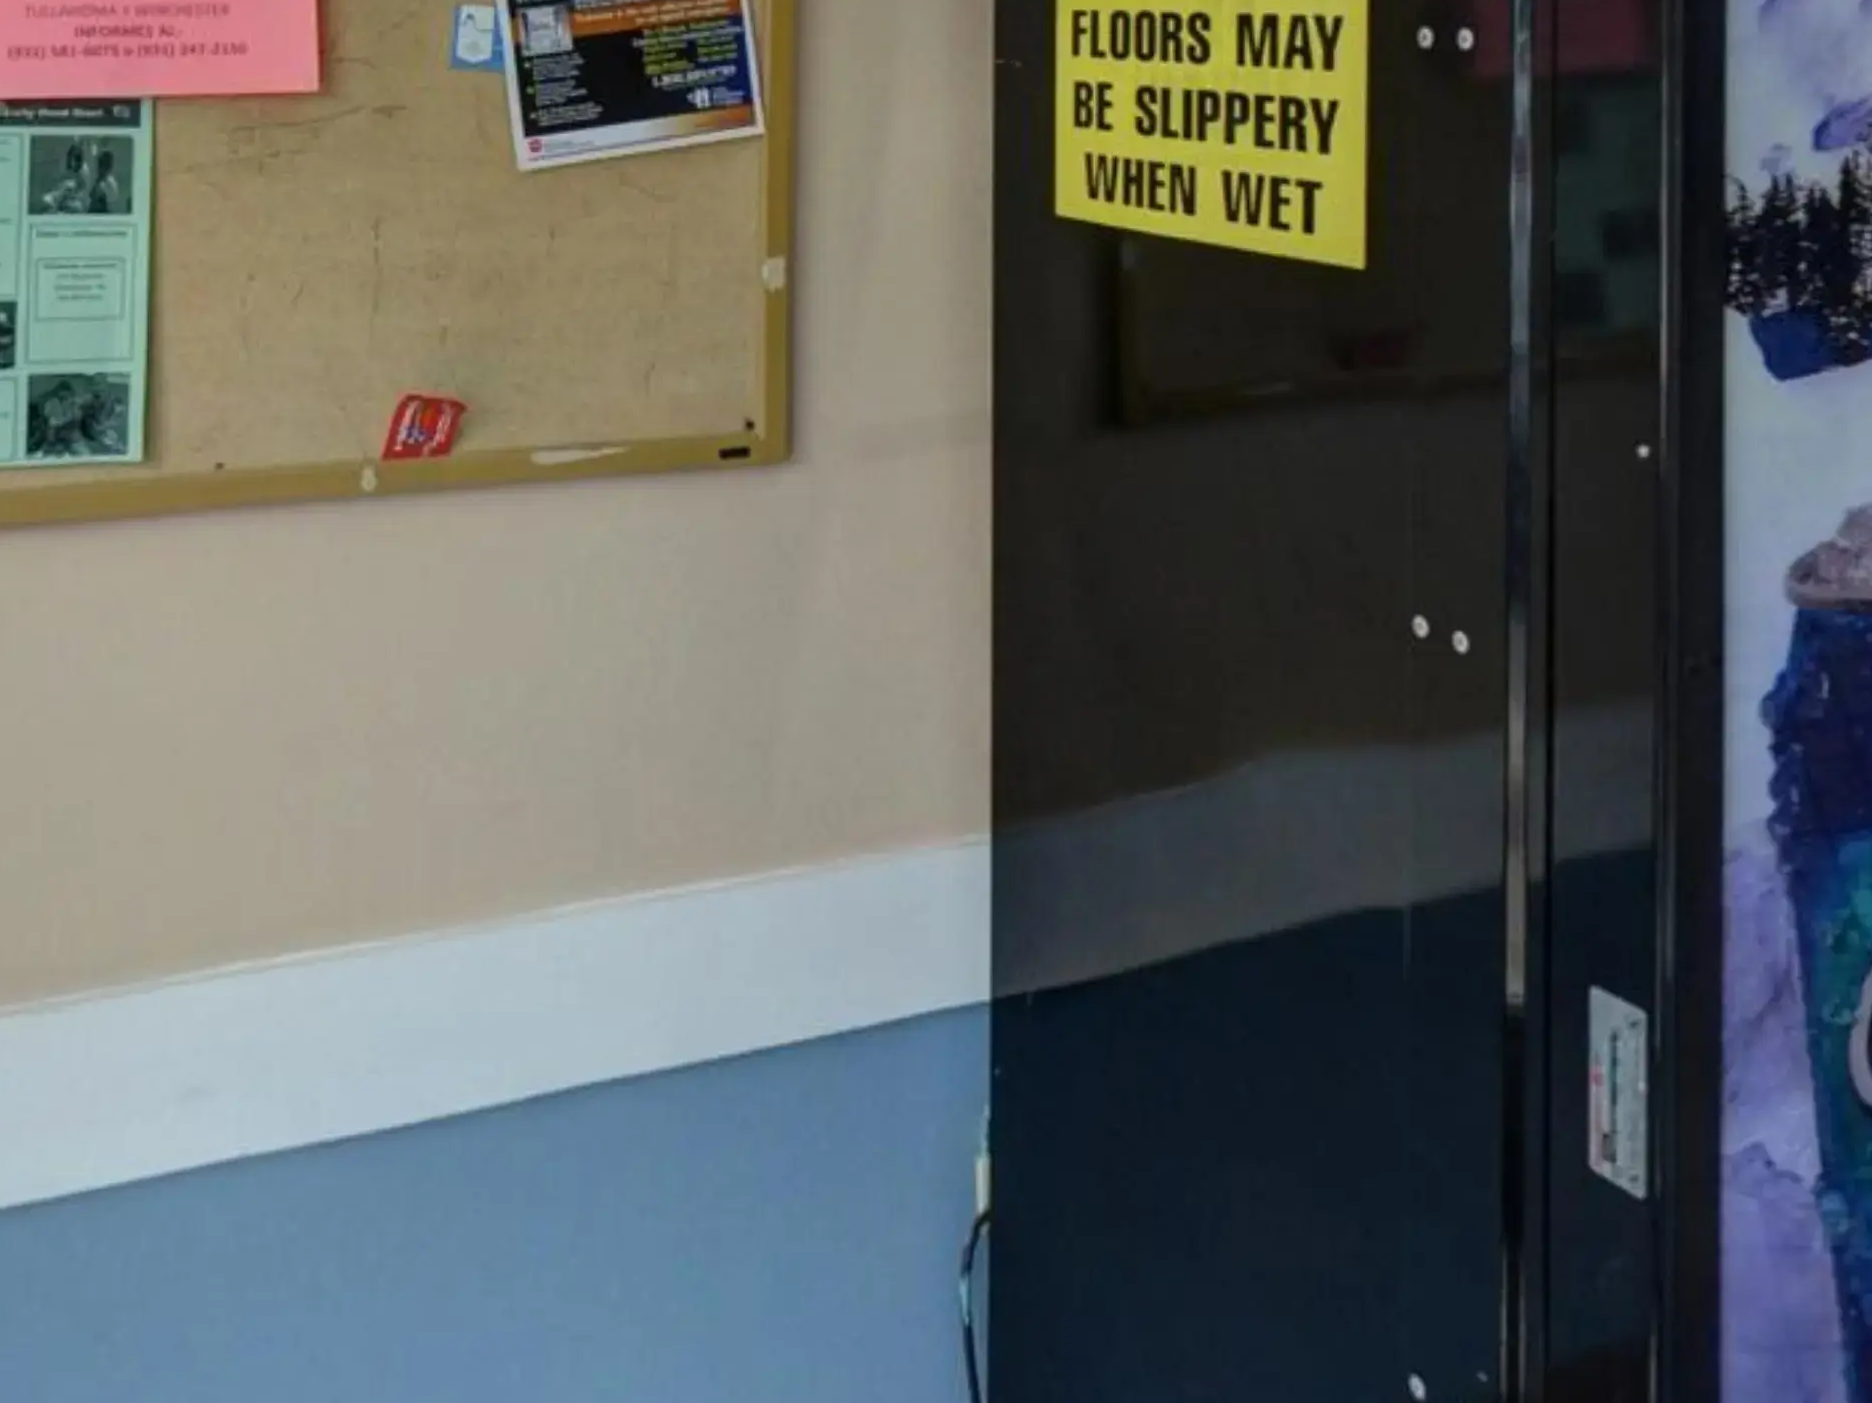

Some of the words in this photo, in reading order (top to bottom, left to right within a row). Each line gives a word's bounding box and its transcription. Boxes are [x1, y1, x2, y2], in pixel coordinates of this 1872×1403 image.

[1071, 9, 1211, 64] FLOORS
[1236, 13, 1343, 71] MAY
[1074, 81, 1114, 132] BE
[1135, 85, 1339, 155] SLIPPERY
[1084, 152, 1196, 216] WHEN
[1222, 170, 1323, 235] WET
